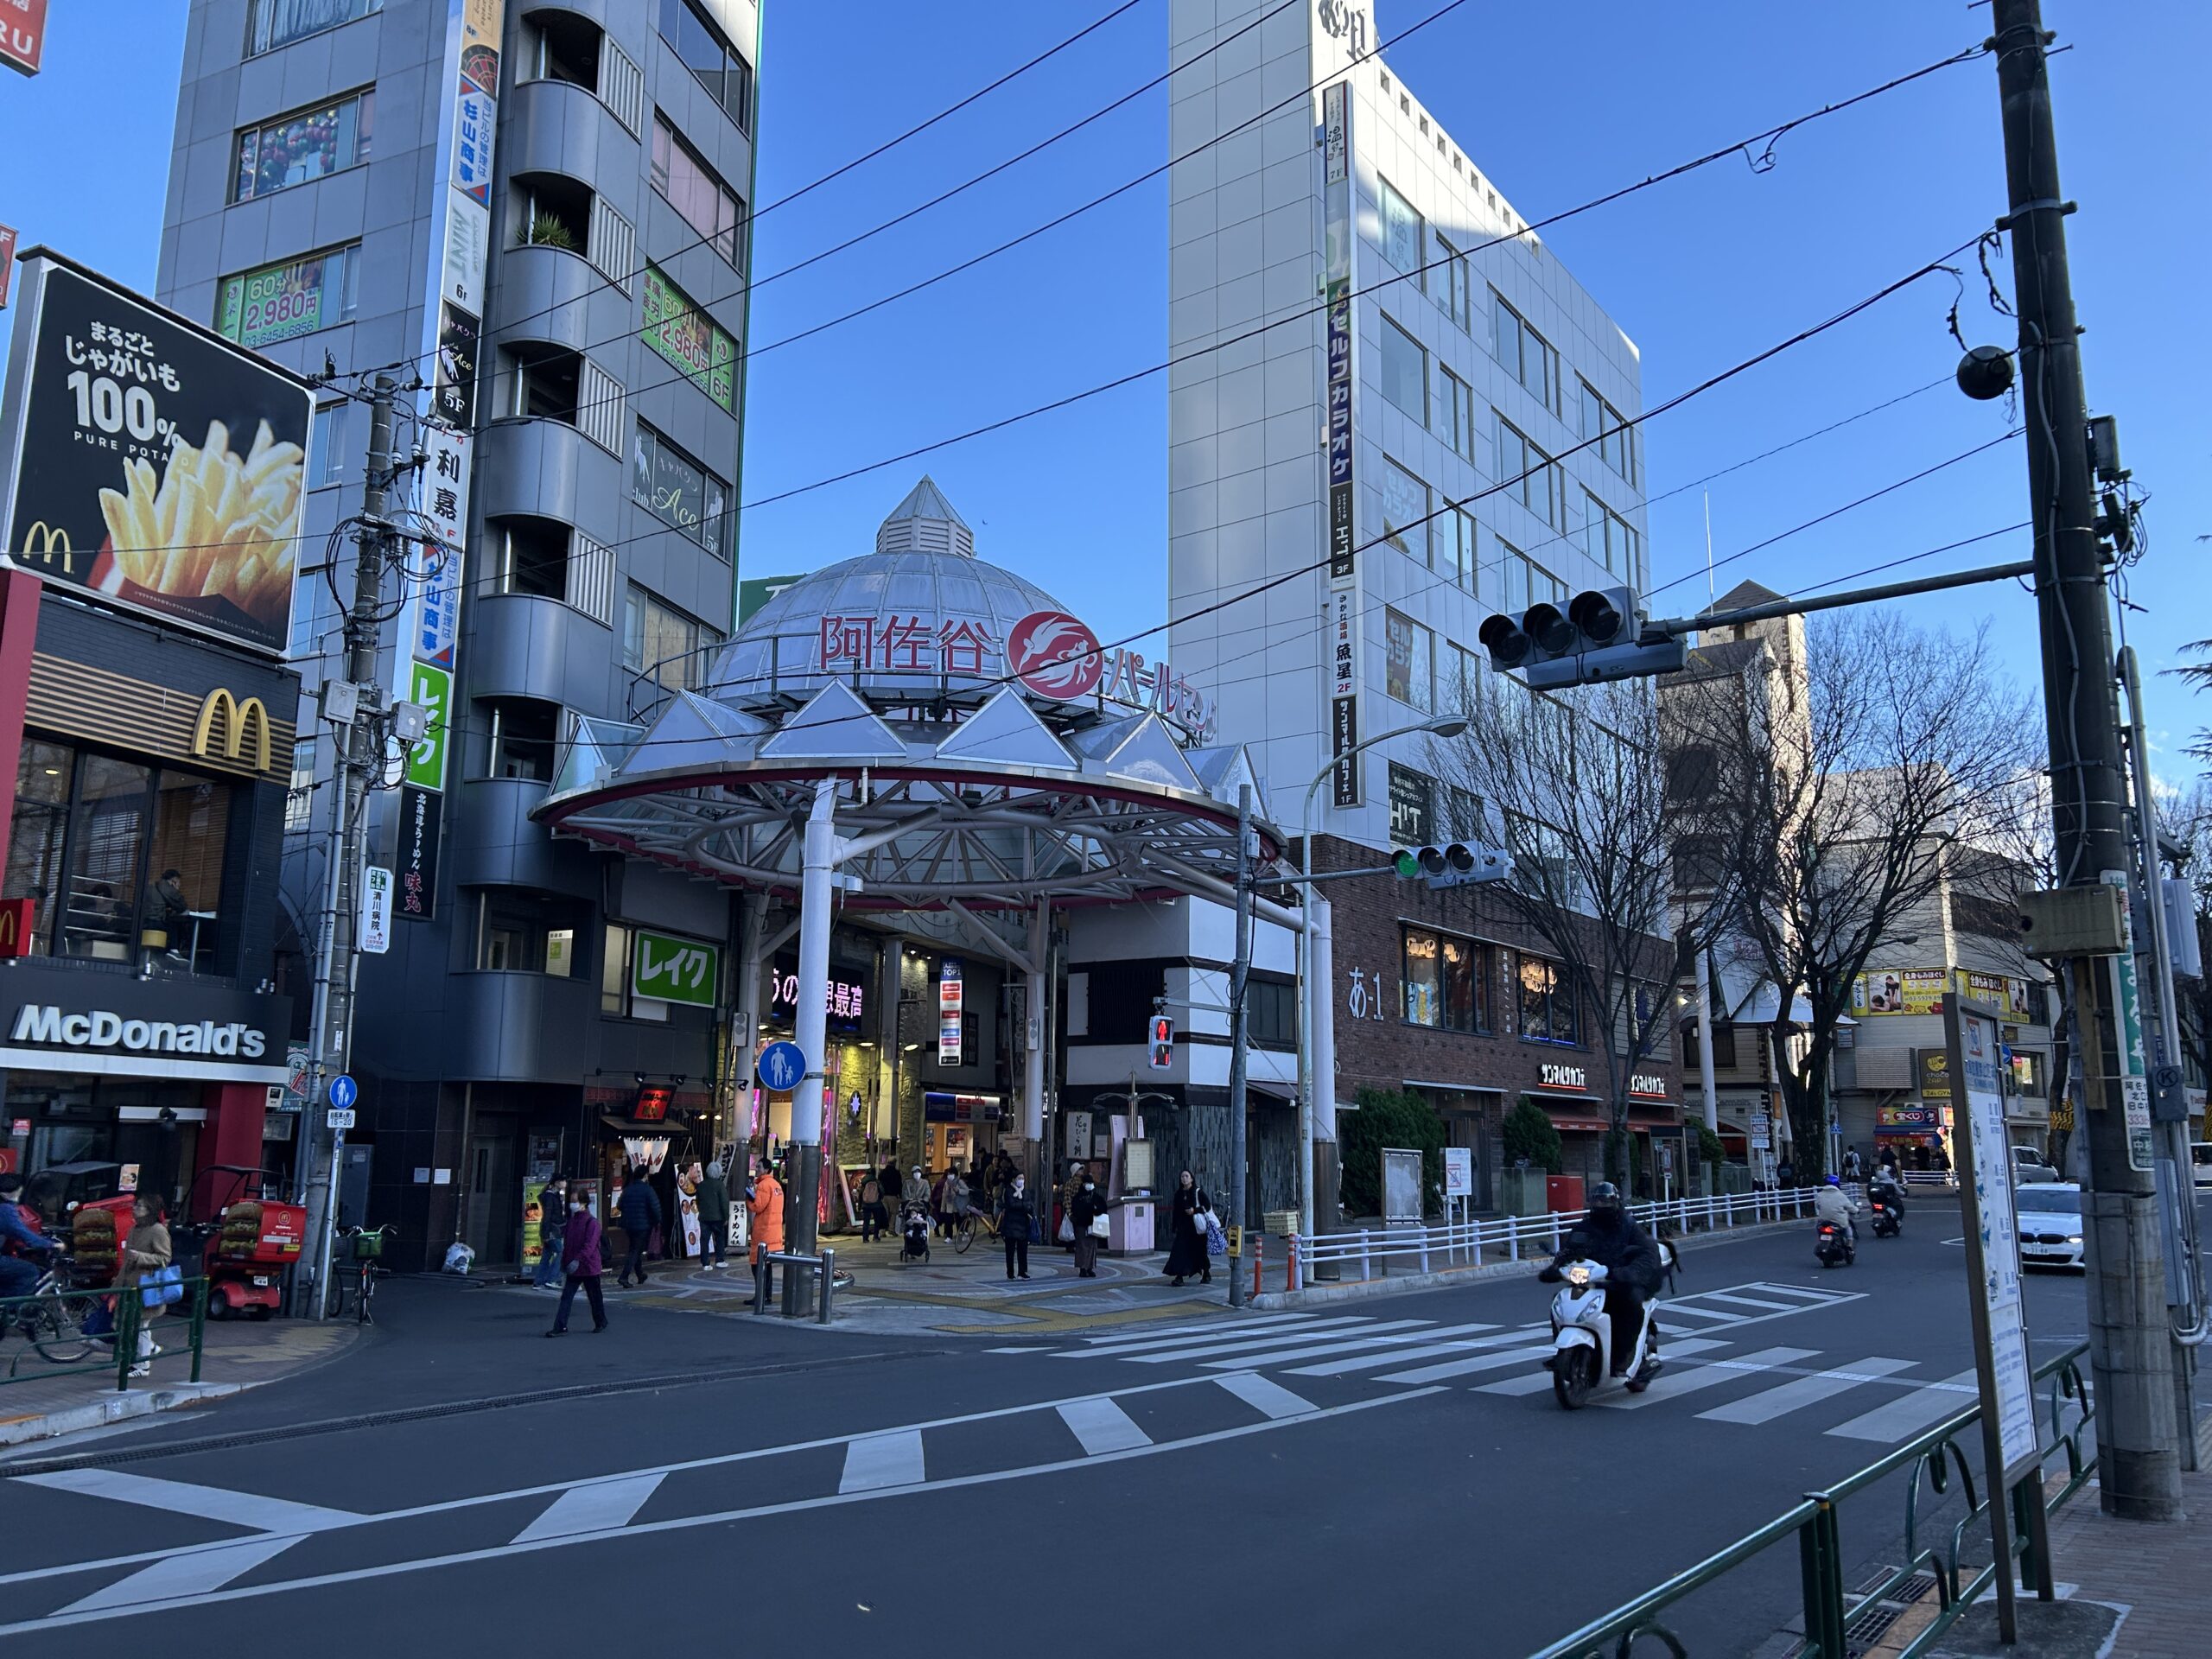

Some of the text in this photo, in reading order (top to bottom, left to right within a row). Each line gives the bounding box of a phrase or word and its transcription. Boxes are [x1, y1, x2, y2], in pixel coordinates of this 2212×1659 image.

[458, 99, 479, 183] 杉山商事
[449, 207, 469, 281] MINT
[249, 276, 288, 301] 60分
[456, 283, 467, 302] 6F
[245, 291, 317, 333] 2,980円
[91, 321, 154, 357] まるごと
[244, 320, 315, 347] 03-6454-6856
[662, 317, 709, 378] 2,980円
[66, 335, 180, 391] じゃがいも
[444, 391, 465, 413] 5F
[713, 377, 729, 401] 6F
[1331, 316, 1349, 475] セルフカラオケ
[67, 370, 178, 447] 100%
[74, 431, 118, 450] PURE
[652, 486, 700, 531] Ace
[1337, 564, 1349, 574] 3F
[819, 613, 993, 675] 阿佐谷
[1336, 643, 1352, 680] 魚星
[1338, 683, 1351, 693] 2F
[1341, 795, 1351, 804] 1F
[404, 792, 426, 913] 北海道らーめん 味丸
[641, 940, 709, 988] レイク
[1969, 975, 2003, 991] 全身もみほぐし
[13, 1004, 266, 1058] McDonald's
[1541, 1064, 1586, 1087] サンマルクカフェ
[1630, 1075, 1666, 1095] サンマルクカフェ
[1896, 1112, 1921, 1121] 宝くじ
[731, 1205, 741, 1240] らーめん
